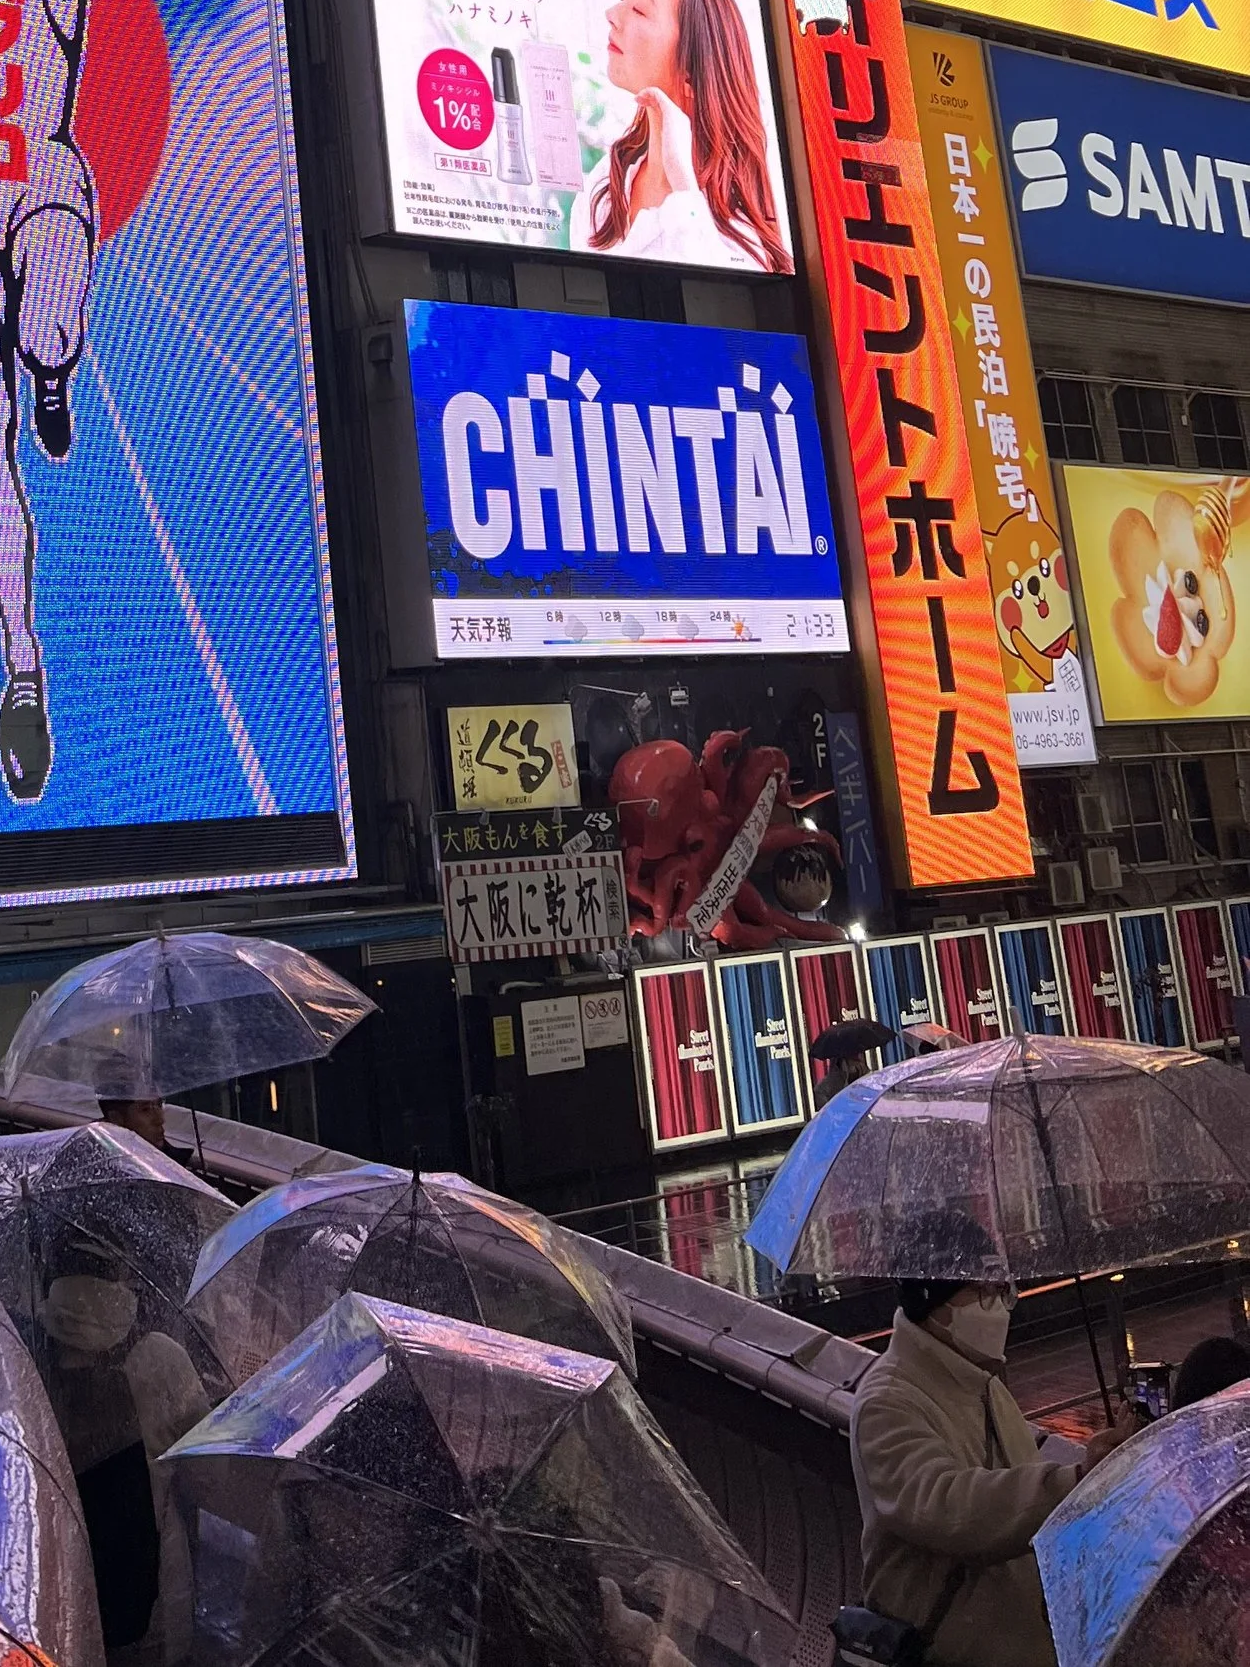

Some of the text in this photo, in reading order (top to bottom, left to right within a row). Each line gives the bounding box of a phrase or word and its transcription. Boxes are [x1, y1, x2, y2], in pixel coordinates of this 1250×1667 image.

[449, 2, 532, 29] ハナミノキ
[437, 61, 469, 76] 女性用
[433, 96, 472, 131] 1%
[940, 94, 969, 110] GROUP
[441, 362, 814, 560] CHINTAI
[449, 615, 513, 643] 天気予報
[546, 610, 732, 623] 6時 12時 18時 24時
[786, 613, 835, 638] 21:33
[1012, 704, 1081, 727] www.jsv.jp
[1015, 732, 1087, 750] 06-4963-3661
[475, 718, 554, 794] くくる
[441, 819, 568, 854] 大阪もんを食す
[456, 871, 601, 944] 大阪に乾杯
